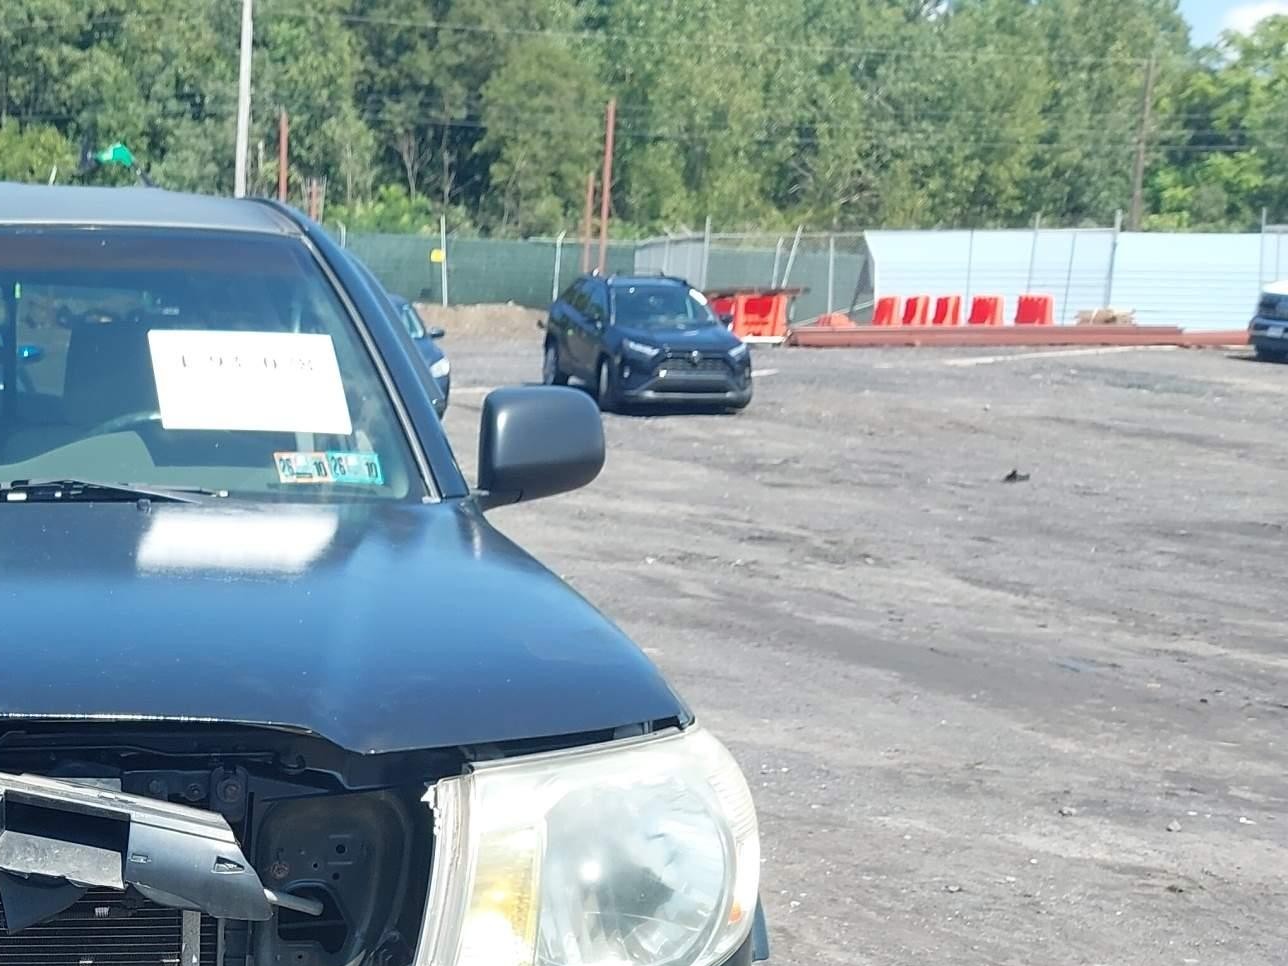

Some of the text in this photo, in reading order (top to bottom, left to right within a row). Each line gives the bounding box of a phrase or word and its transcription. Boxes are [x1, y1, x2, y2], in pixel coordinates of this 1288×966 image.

[313, 461, 328, 477] 10
[330, 456, 379, 478] 26 10
